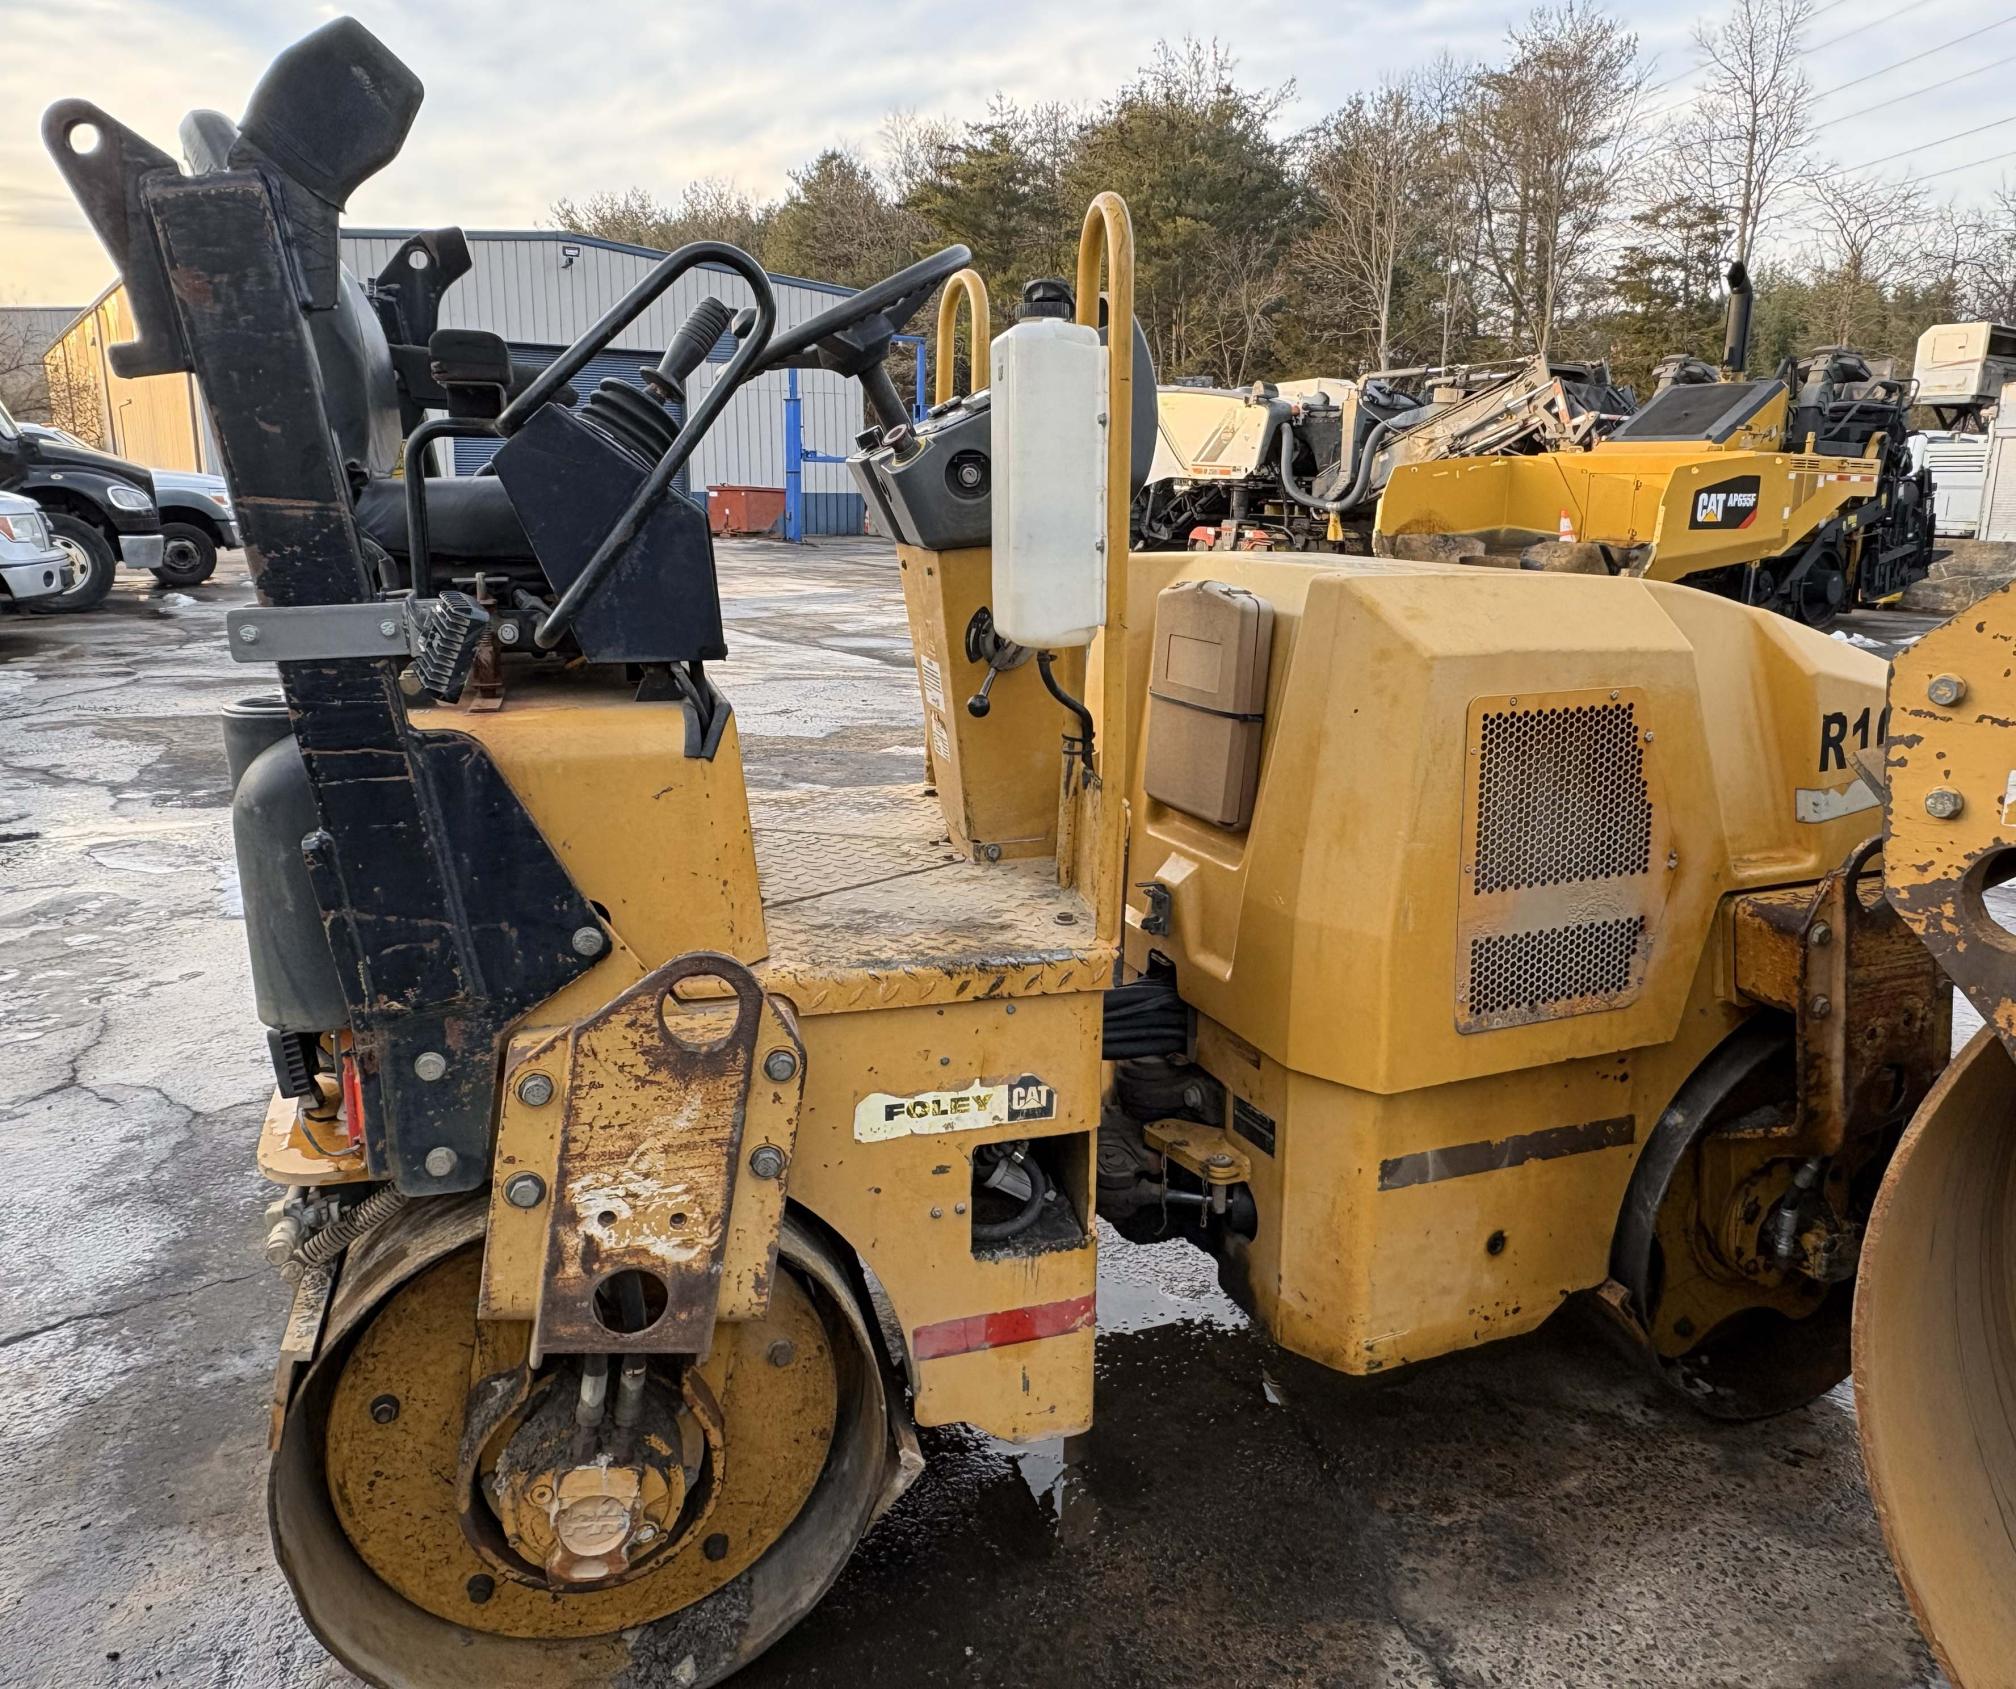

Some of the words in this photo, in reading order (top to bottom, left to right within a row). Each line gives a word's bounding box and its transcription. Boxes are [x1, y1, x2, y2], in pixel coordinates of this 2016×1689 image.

[1696, 492, 1727, 522] CAT
[884, 1093, 994, 1122] FOLEY
[1012, 1085, 1051, 1111] CAT
